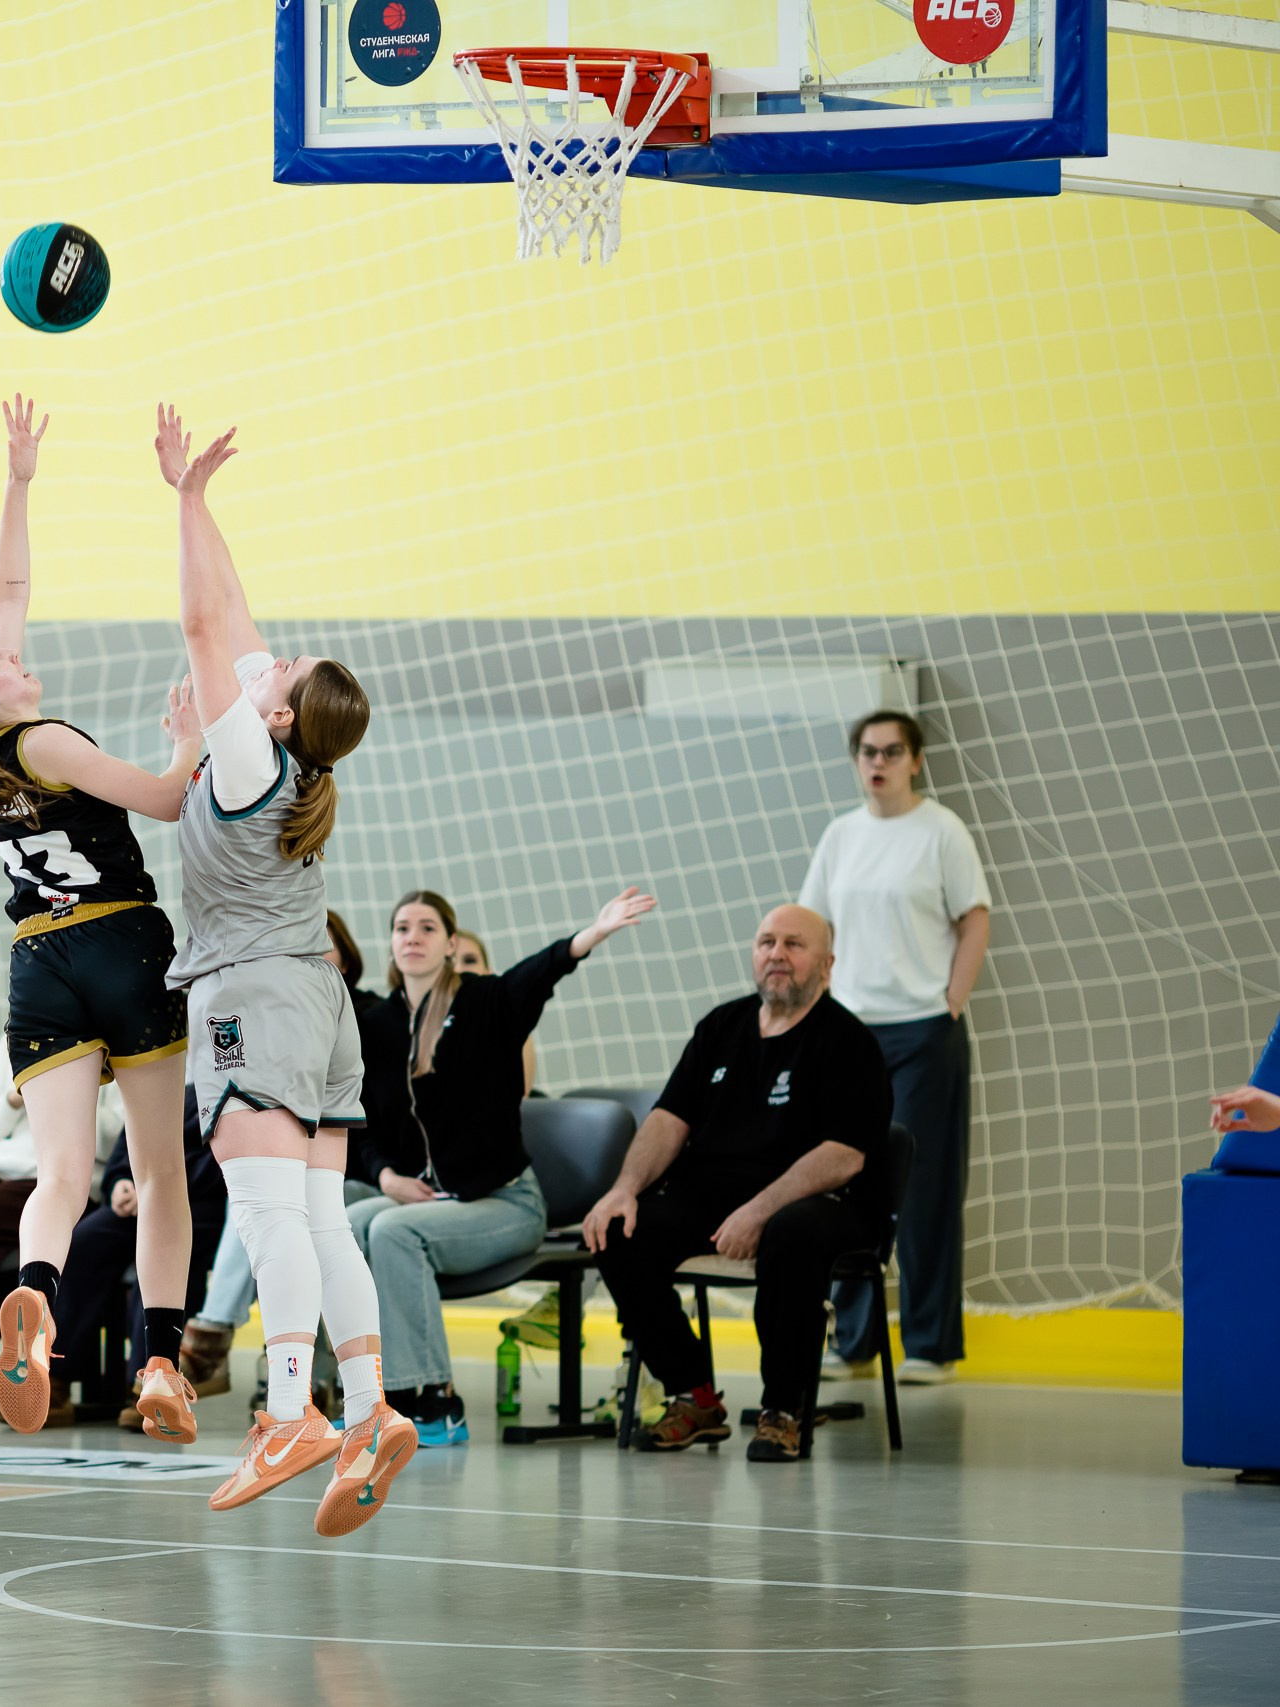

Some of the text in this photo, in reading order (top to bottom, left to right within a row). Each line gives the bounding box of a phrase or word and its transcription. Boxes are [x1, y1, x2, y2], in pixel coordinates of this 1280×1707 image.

[360, 33, 430, 47] СТУДЕНЧЕСКАЯ
[372, 47, 418, 59] ЛИГА РЖД
[214, 1061, 246, 1072] МЕДВЕДИ
